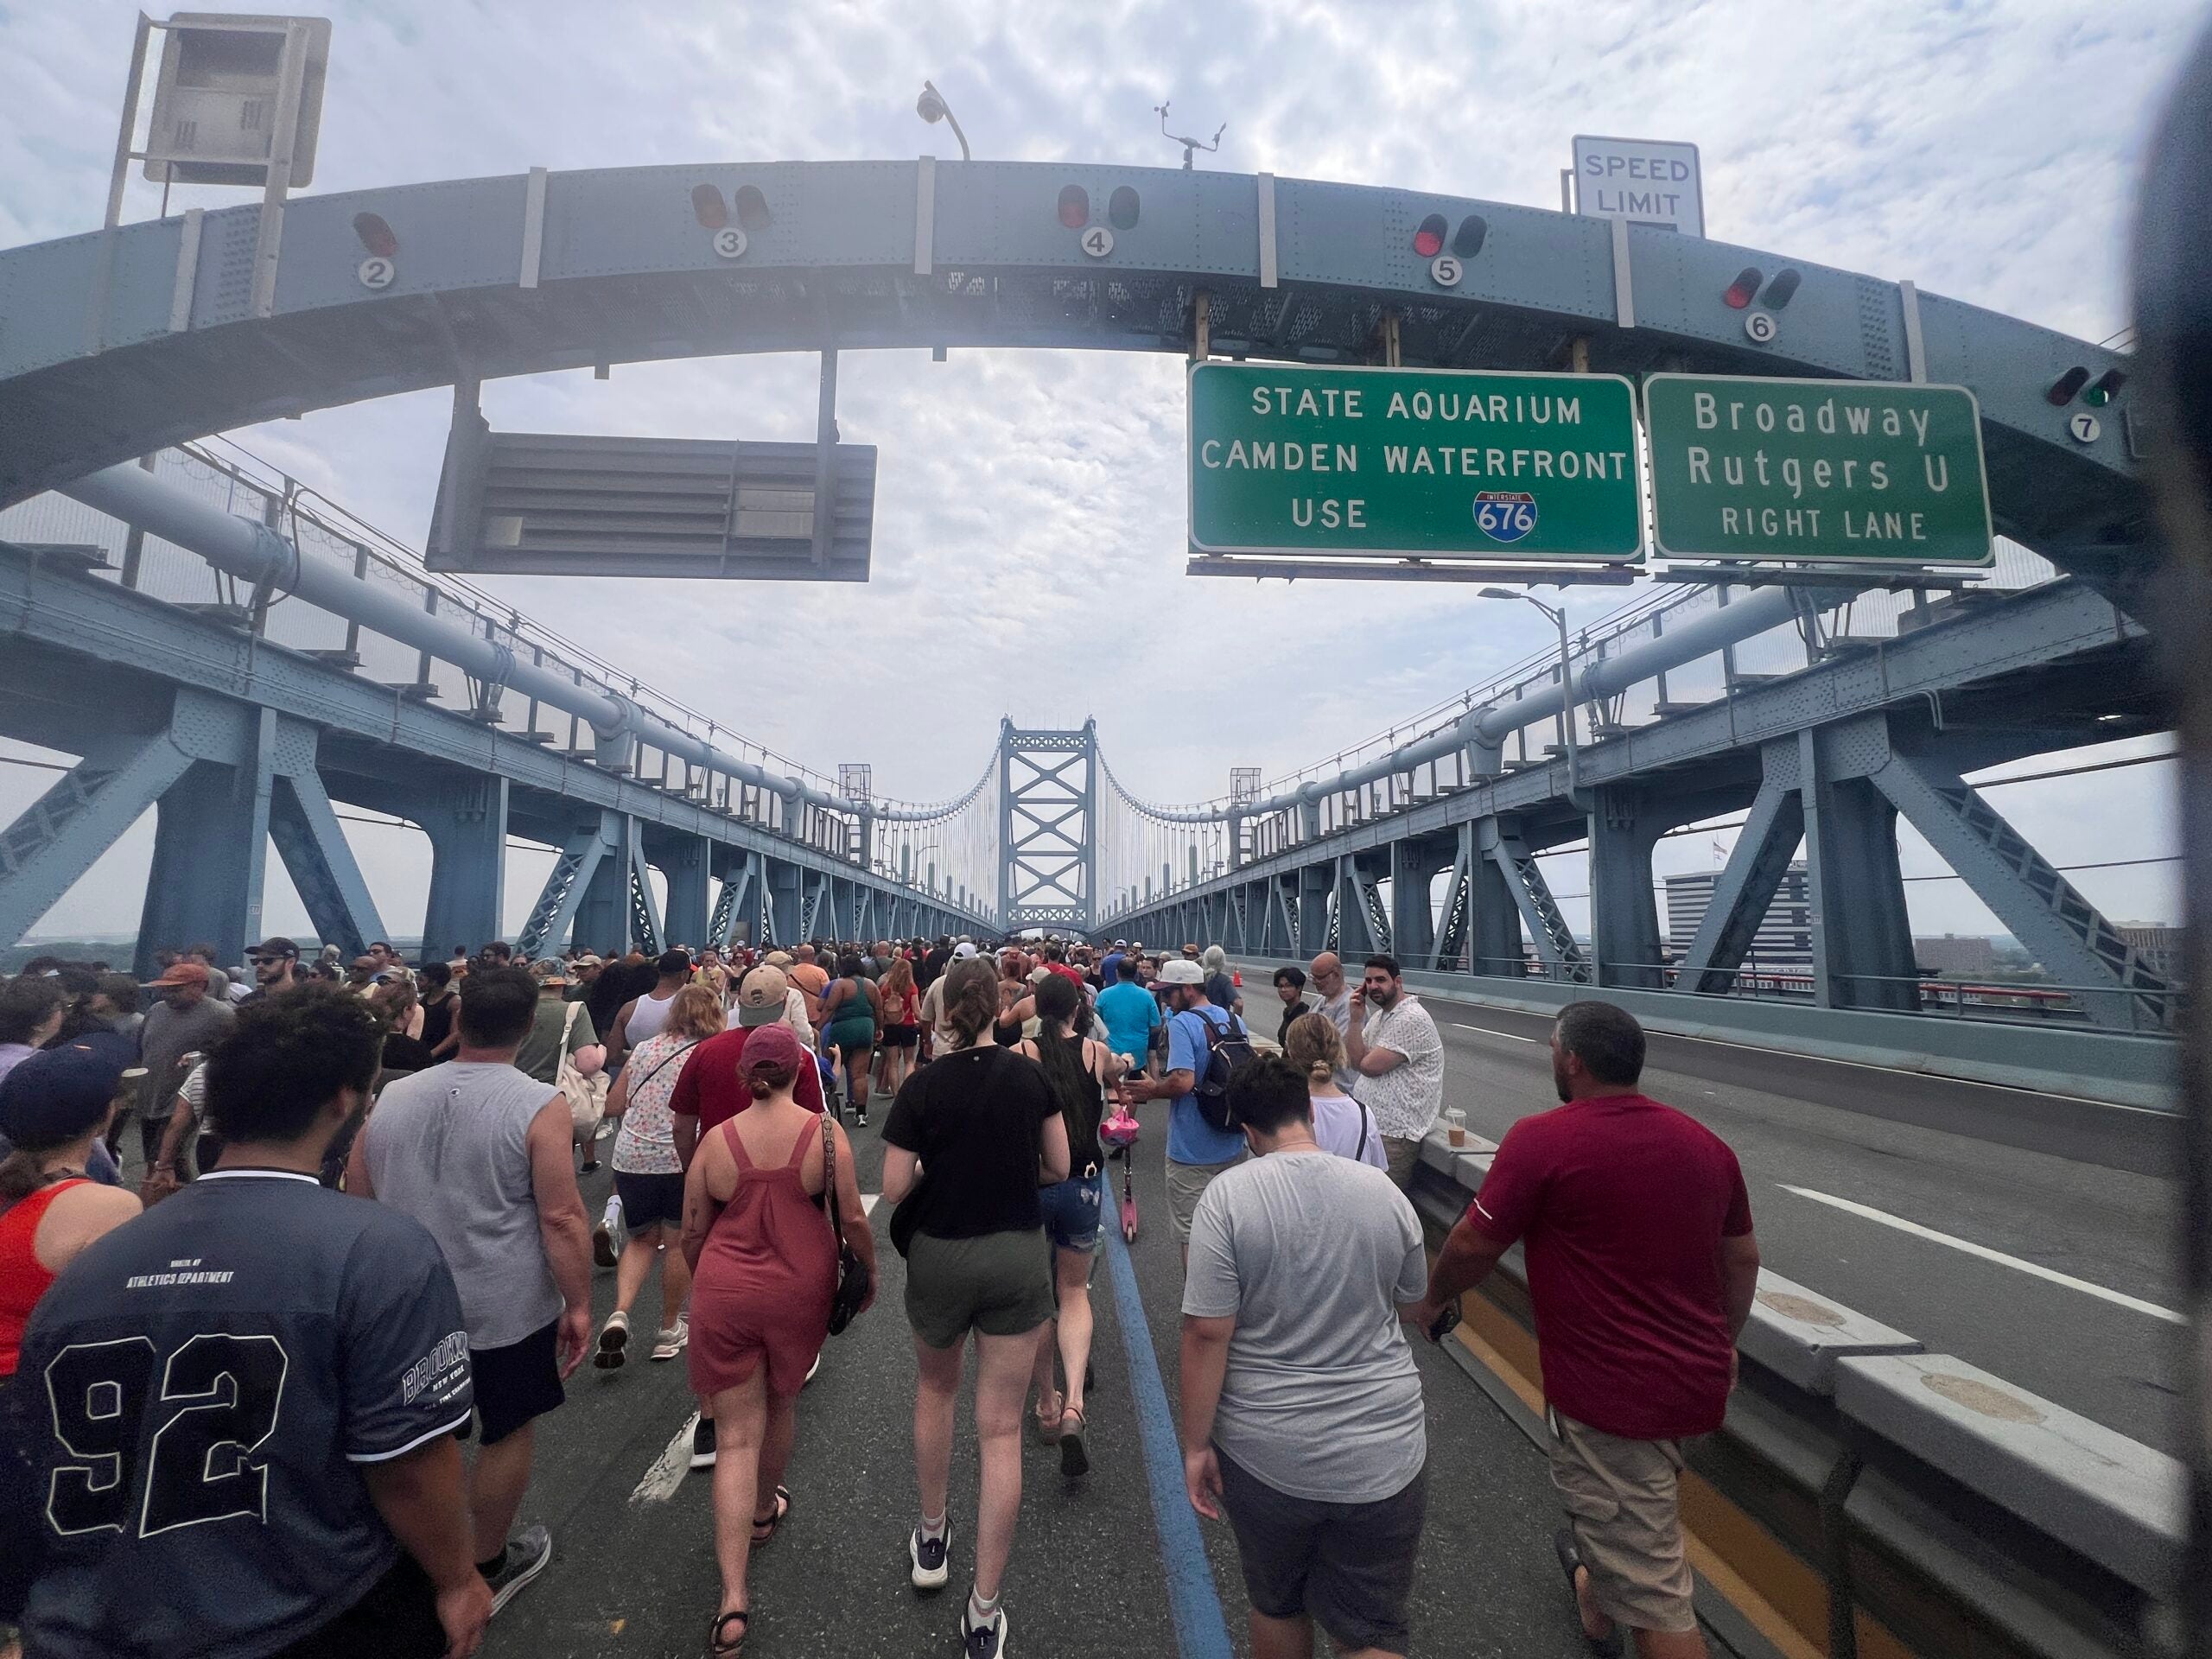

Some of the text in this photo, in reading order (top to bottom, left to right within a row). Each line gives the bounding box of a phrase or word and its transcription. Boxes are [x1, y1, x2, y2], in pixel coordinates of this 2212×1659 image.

[1586, 154, 1689, 181] SPEED
[1598, 189, 1681, 215] LIMIT
[721, 232, 740, 253] 3
[1086, 232, 1105, 252] 4
[367, 262, 386, 284] 2
[1438, 261, 1455, 281] 5
[1752, 317, 1770, 338] 6
[1252, 385, 1581, 425] STATE AQUARIUM
[1694, 392, 1929, 447] Broadway
[2077, 418, 2093, 438] 7
[1201, 439, 1627, 480] CAMDEN WATERFRONT
[1688, 446, 1948, 499] Rutgers U
[1292, 498, 1367, 529] USE
[1478, 503, 1533, 531] 676
[1722, 507, 1927, 541] RIGHT LANE
[432, 1364, 465, 1392] NEW YORK
[44, 1332, 289, 1539] 92
